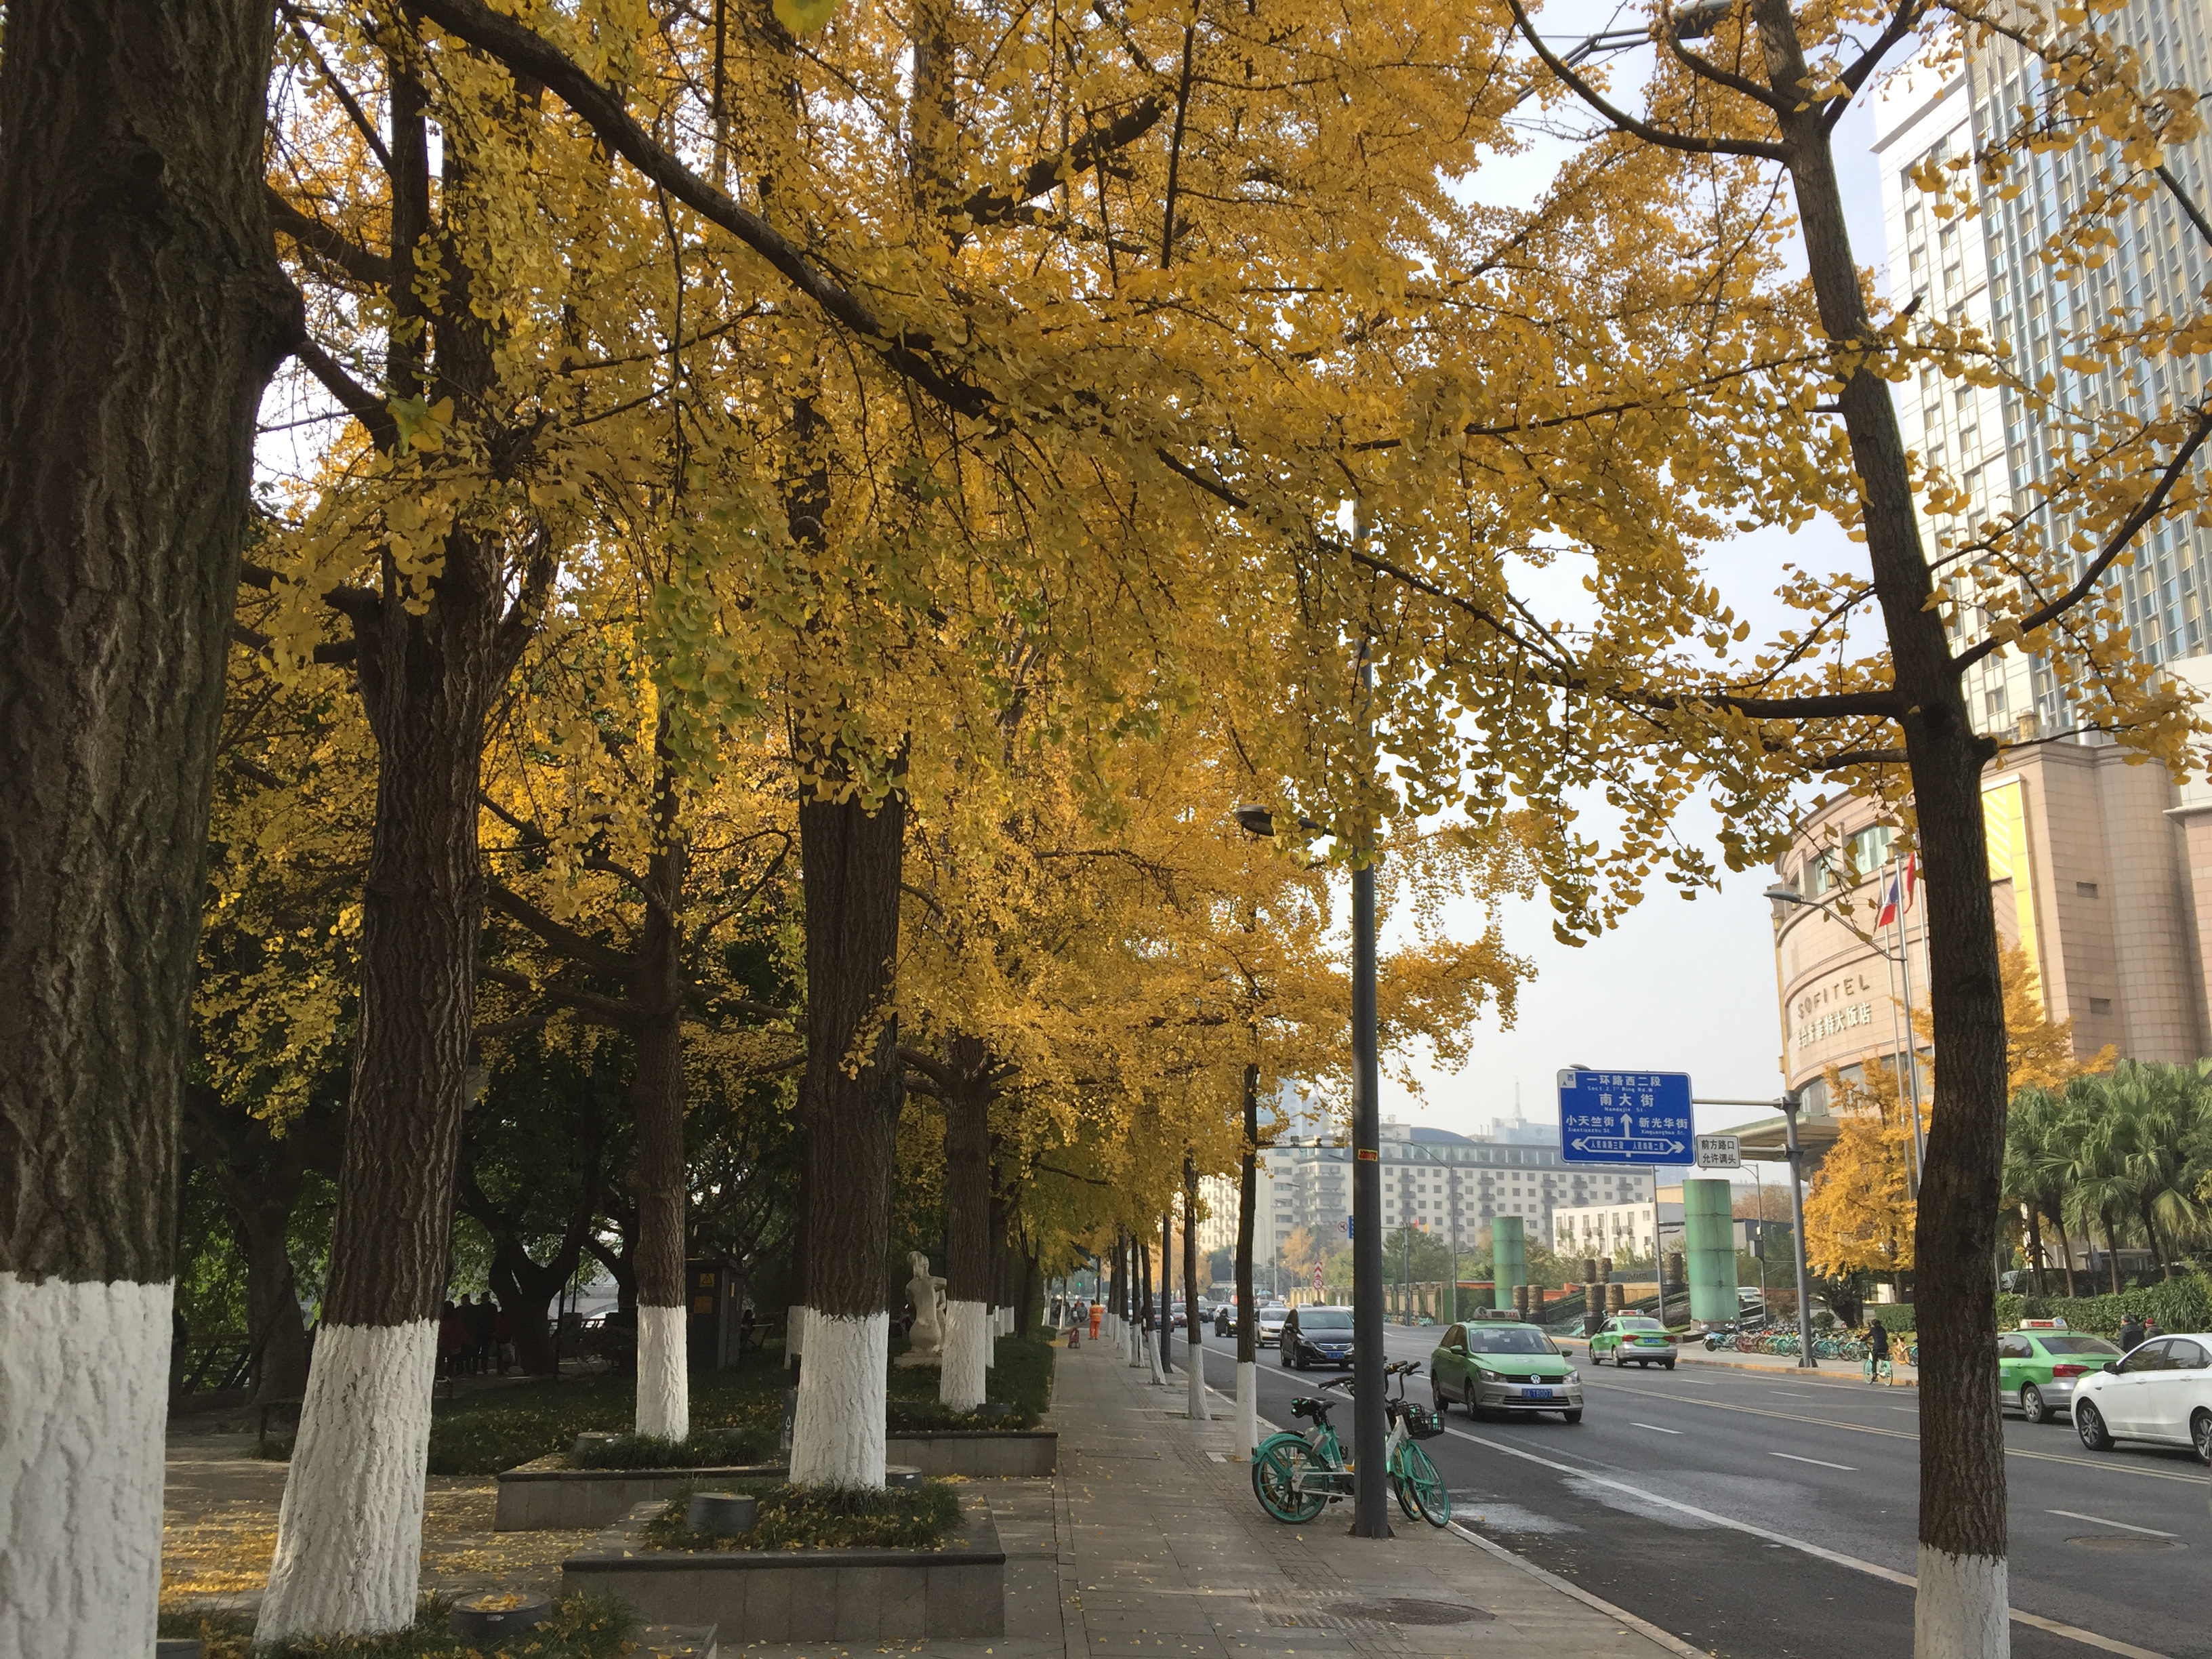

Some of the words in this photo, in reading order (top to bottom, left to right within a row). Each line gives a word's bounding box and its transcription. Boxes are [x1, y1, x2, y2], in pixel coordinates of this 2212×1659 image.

[1798, 975, 1870, 1019] SOFITEL
[1586, 1075, 1662, 1087] 一环路西二段
[1599, 1093, 1654, 1107] 南大街
[1565, 1115, 1614, 1127] 小天竺街
[1639, 1117, 1688, 1129] 新光华街
[1701, 1139, 1734, 1150] 前方路口
[1702, 1153, 1736, 1164] 允许调头
